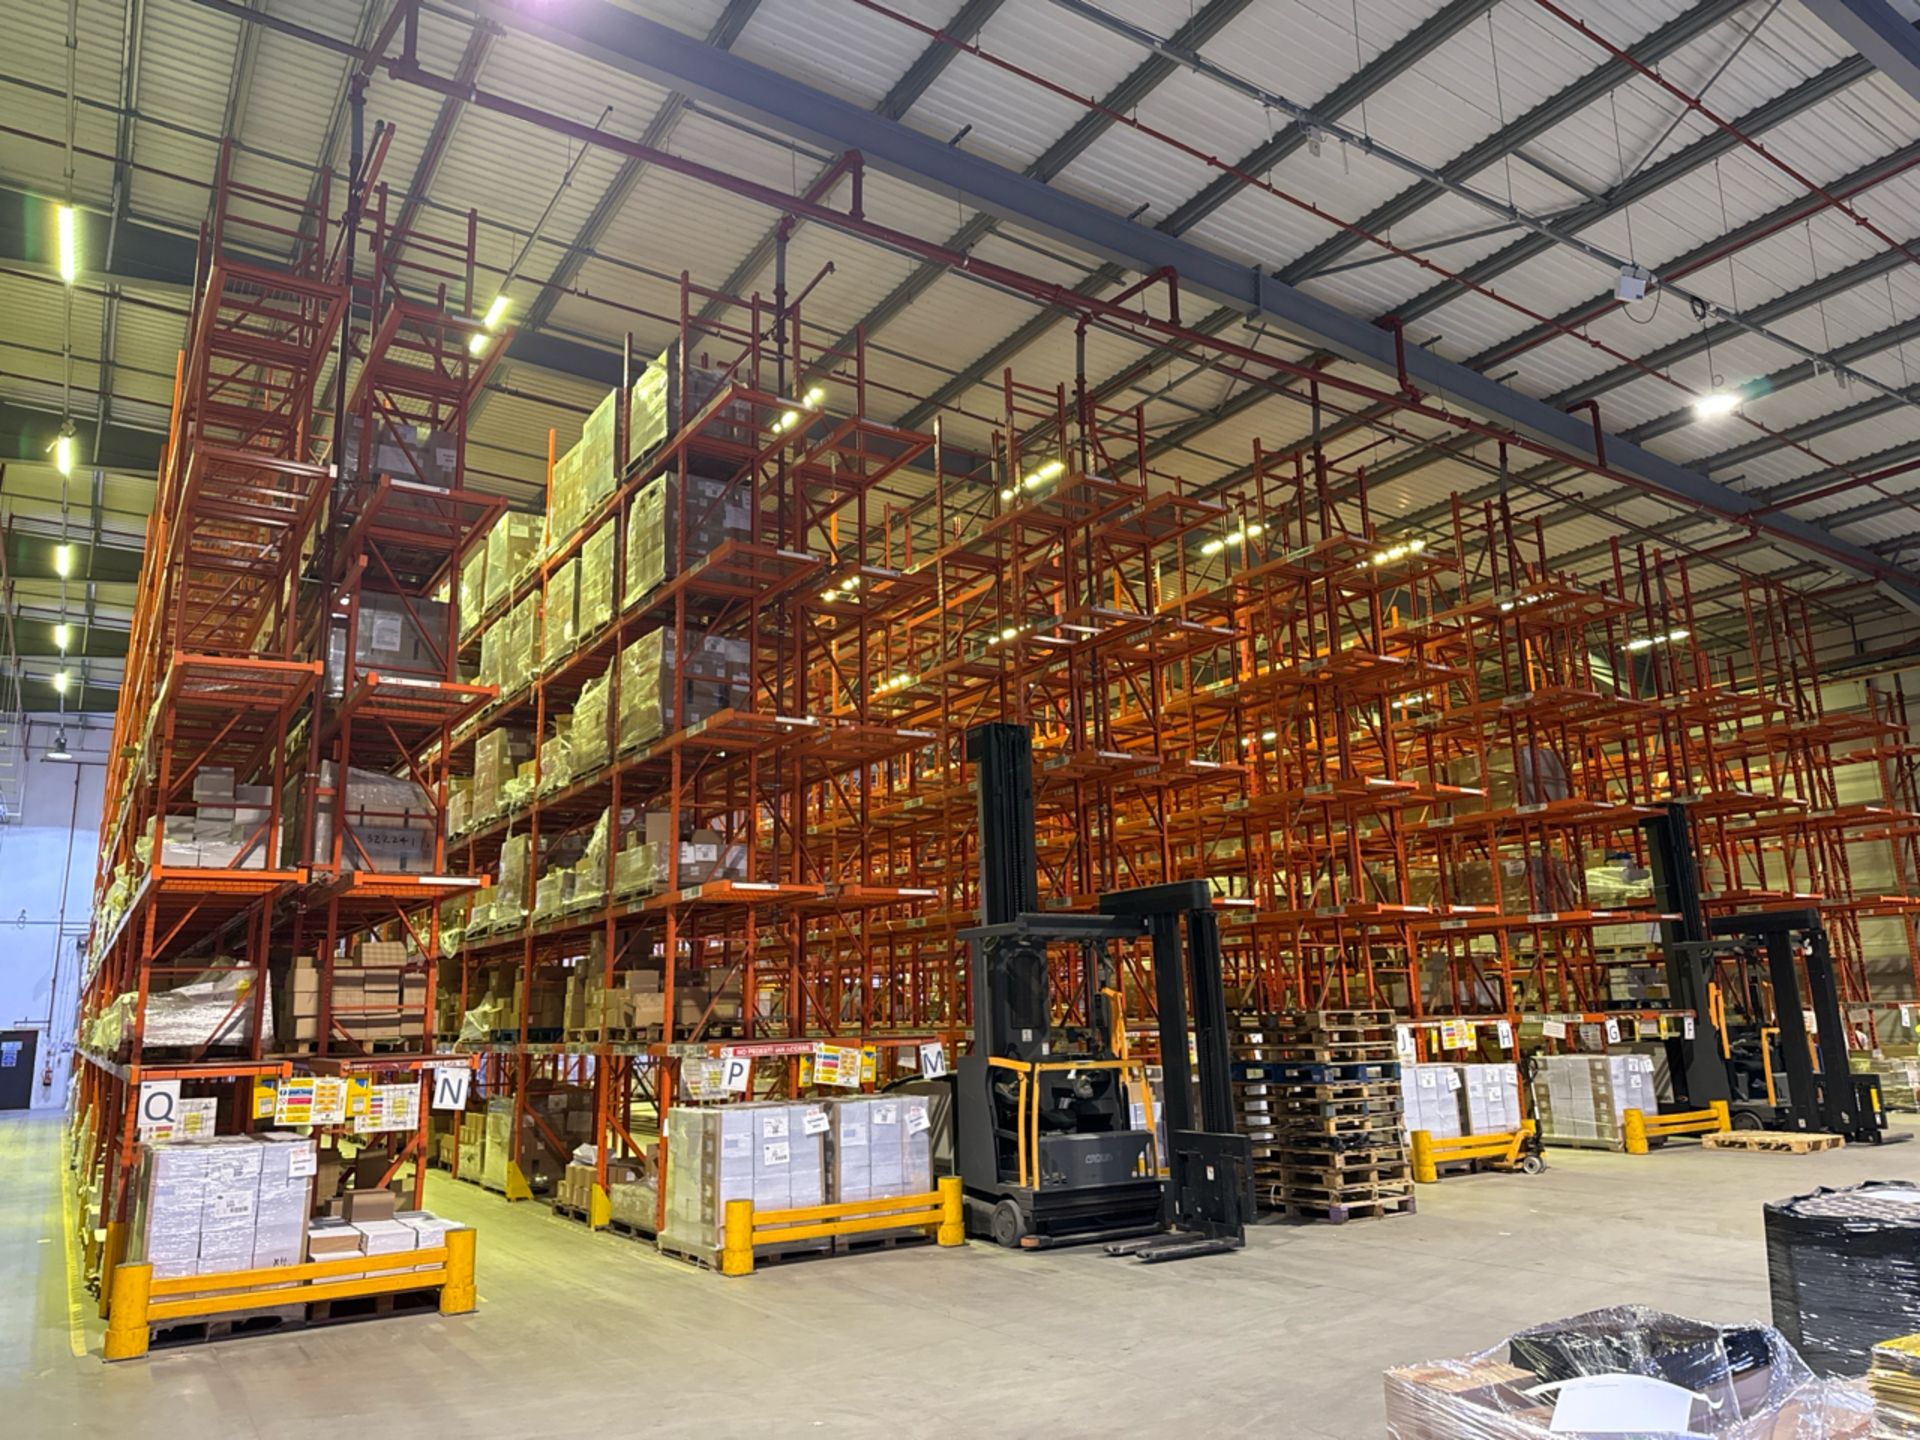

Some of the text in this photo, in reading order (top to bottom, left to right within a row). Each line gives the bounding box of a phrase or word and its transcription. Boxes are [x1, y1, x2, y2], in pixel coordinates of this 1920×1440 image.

[1401, 1033, 1407, 1051] J
[1501, 1028, 1511, 1046] H
[1609, 1025, 1618, 1040] G
[786, 1044, 810, 1053] ACCESS
[923, 1050, 945, 1074] M
[728, 1061, 744, 1085] P
[439, 1077, 463, 1104] N
[144, 1091, 176, 1123] Q
